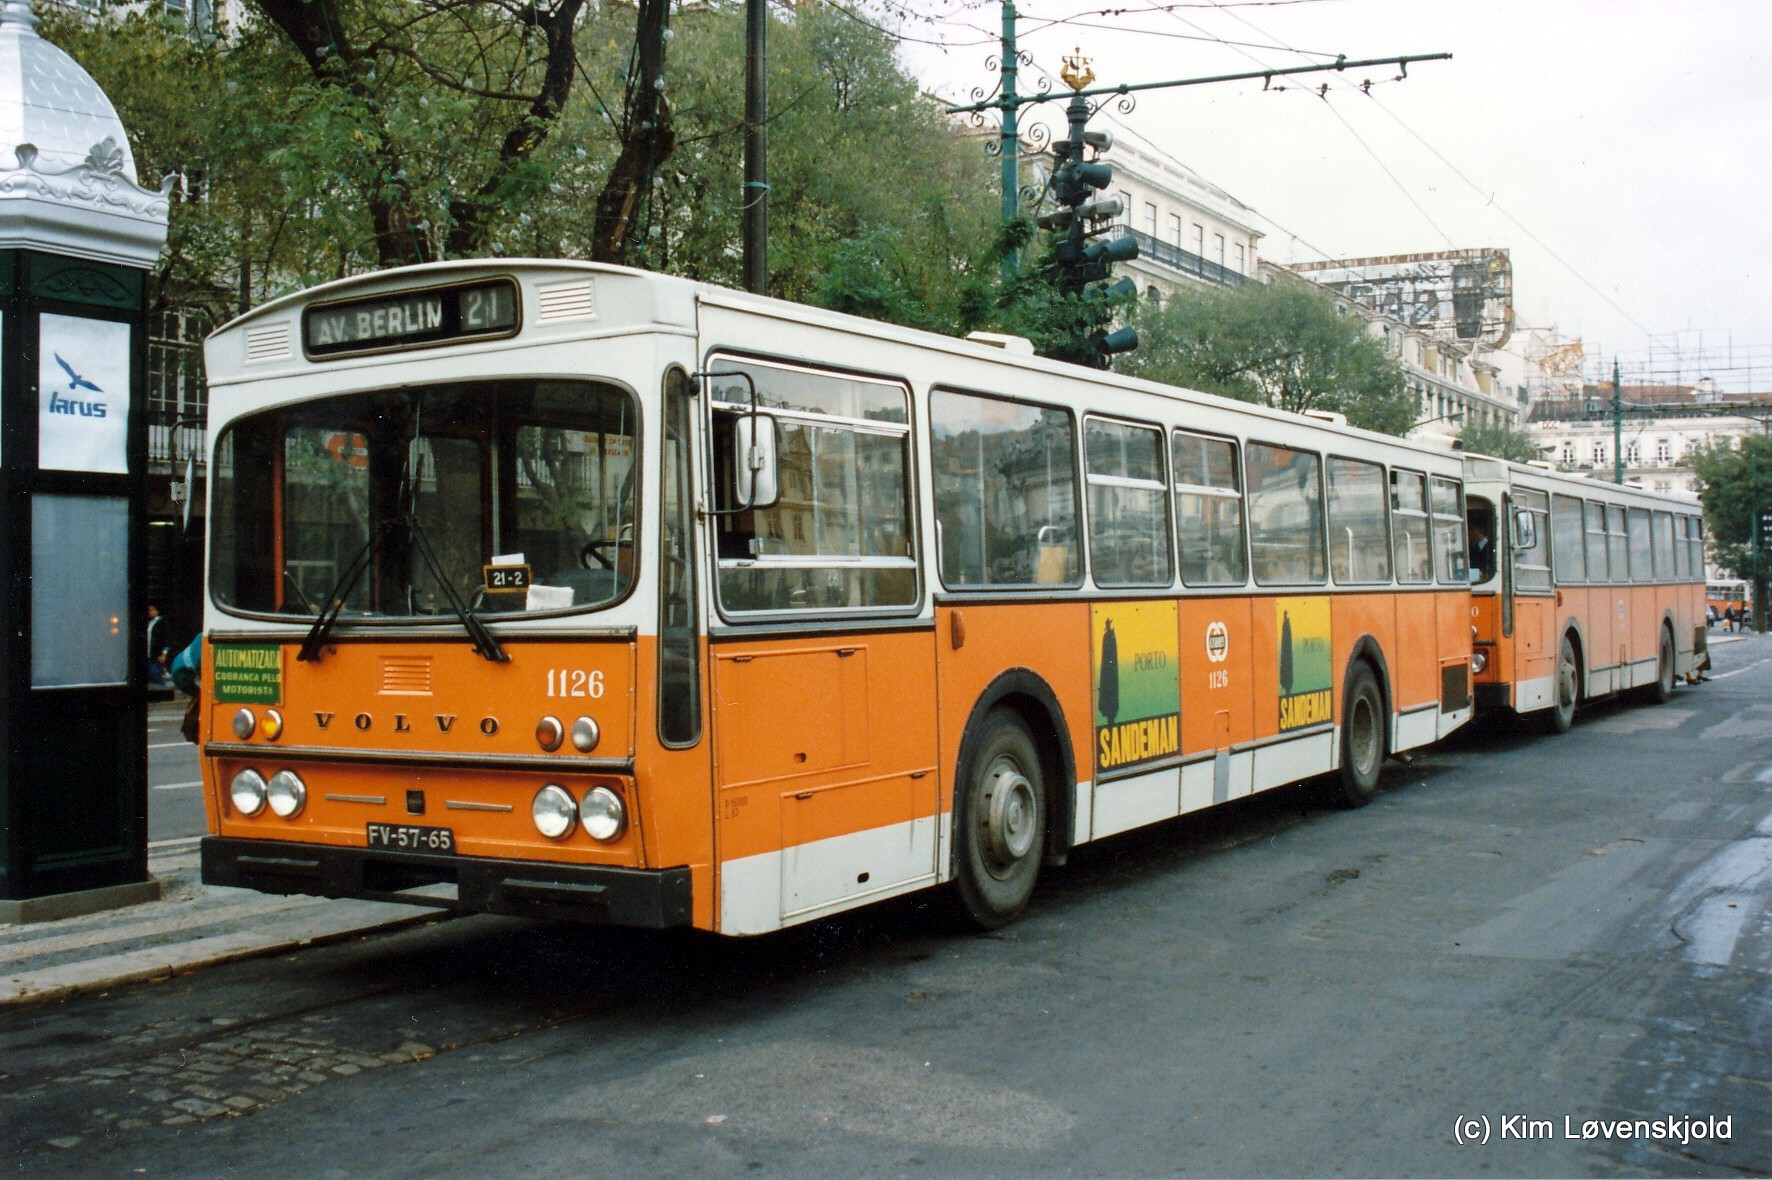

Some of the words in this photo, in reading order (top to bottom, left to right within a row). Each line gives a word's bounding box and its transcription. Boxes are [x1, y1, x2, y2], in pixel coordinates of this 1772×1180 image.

[468, 290, 498, 325] 21
[318, 316, 348, 345] AV.
[494, 571, 523, 586] 21-2
[1134, 651, 1167, 673] PORTO
[222, 685, 274, 695] MOTORISTA
[547, 669, 604, 698] 1126
[1209, 669, 1228, 689] 1126
[1280, 690, 1332, 730] SANDEMAN
[313, 711, 500, 736] VOLVO
[1100, 715, 1179, 769] SANDEMAN
[368, 825, 450, 850] FV-57-65
